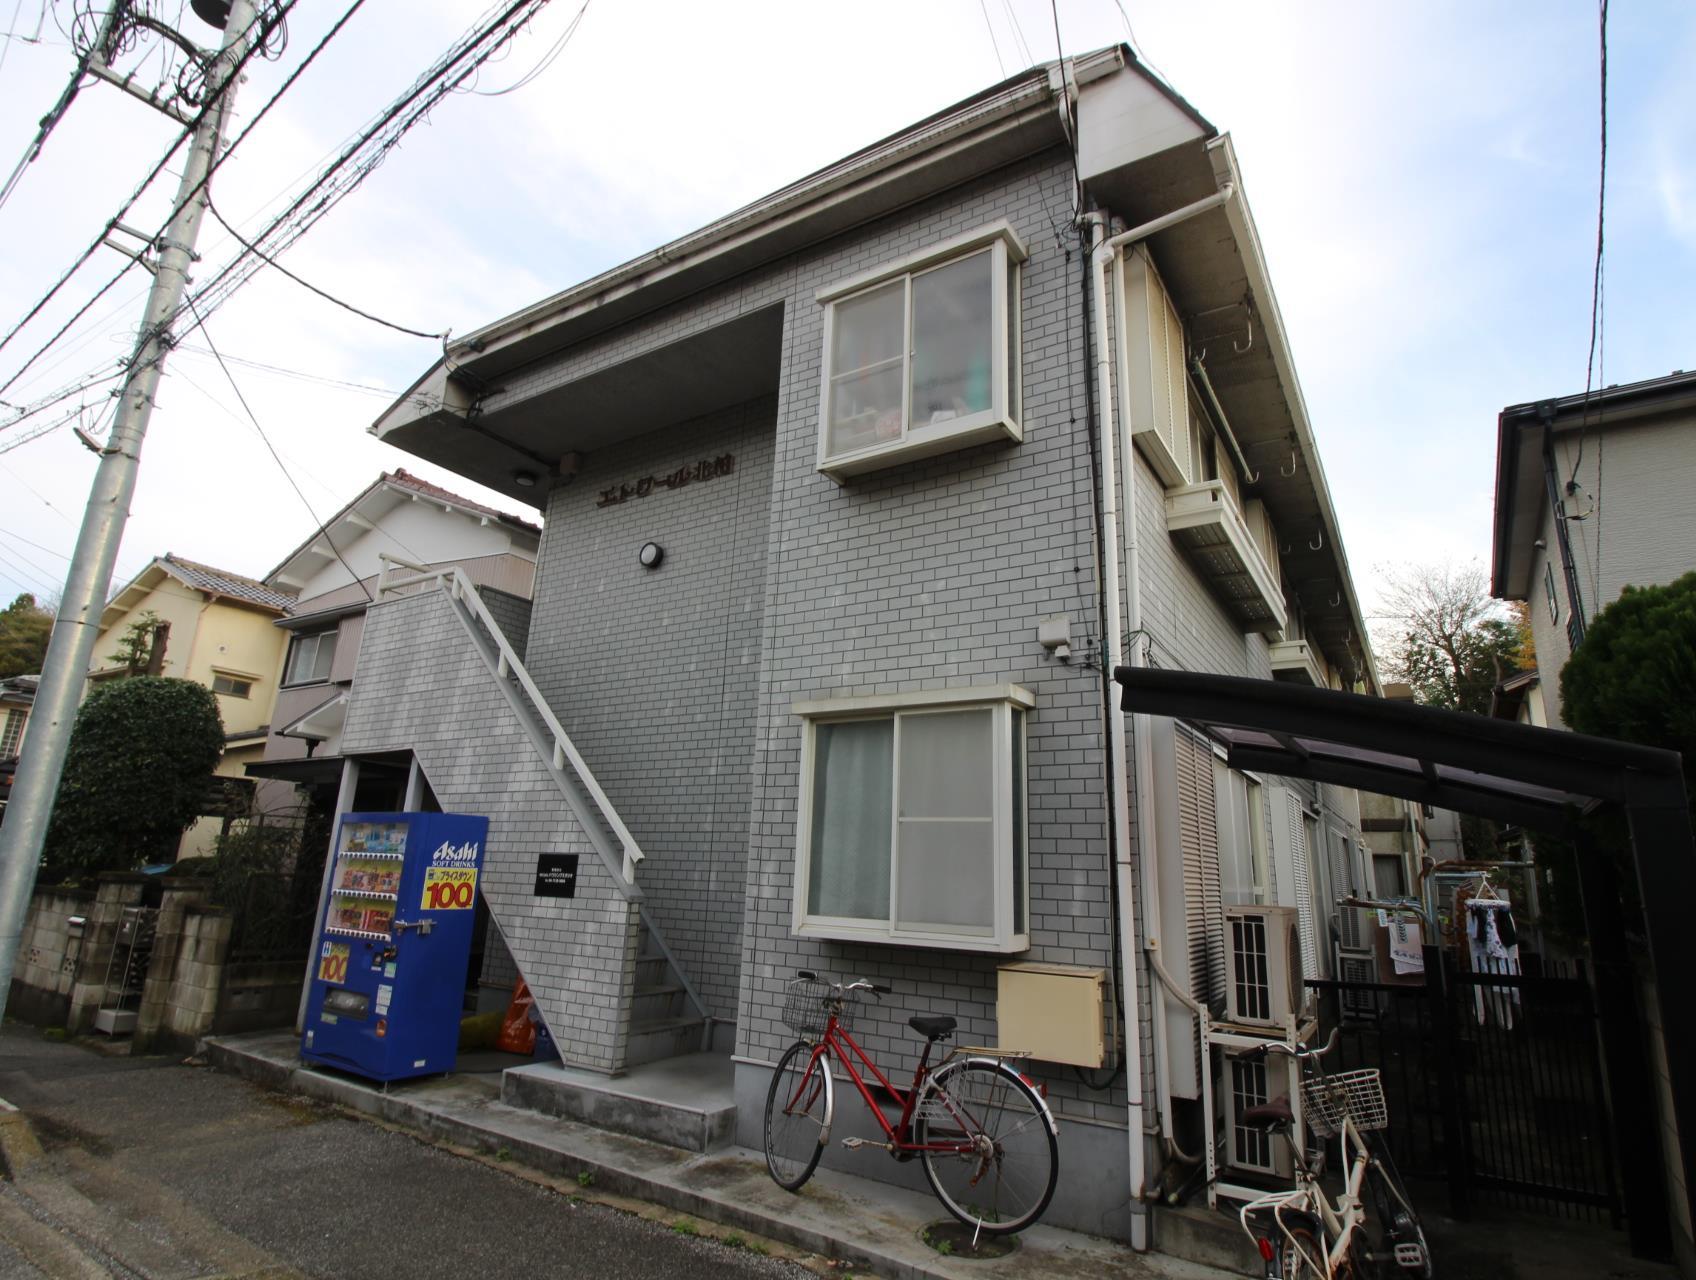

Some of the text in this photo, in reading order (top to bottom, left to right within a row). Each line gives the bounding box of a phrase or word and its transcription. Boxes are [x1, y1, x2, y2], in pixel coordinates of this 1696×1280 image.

[433, 840, 478, 861] Asahi
[432, 860, 449, 868] SOFT
[427, 882, 473, 909] 100
